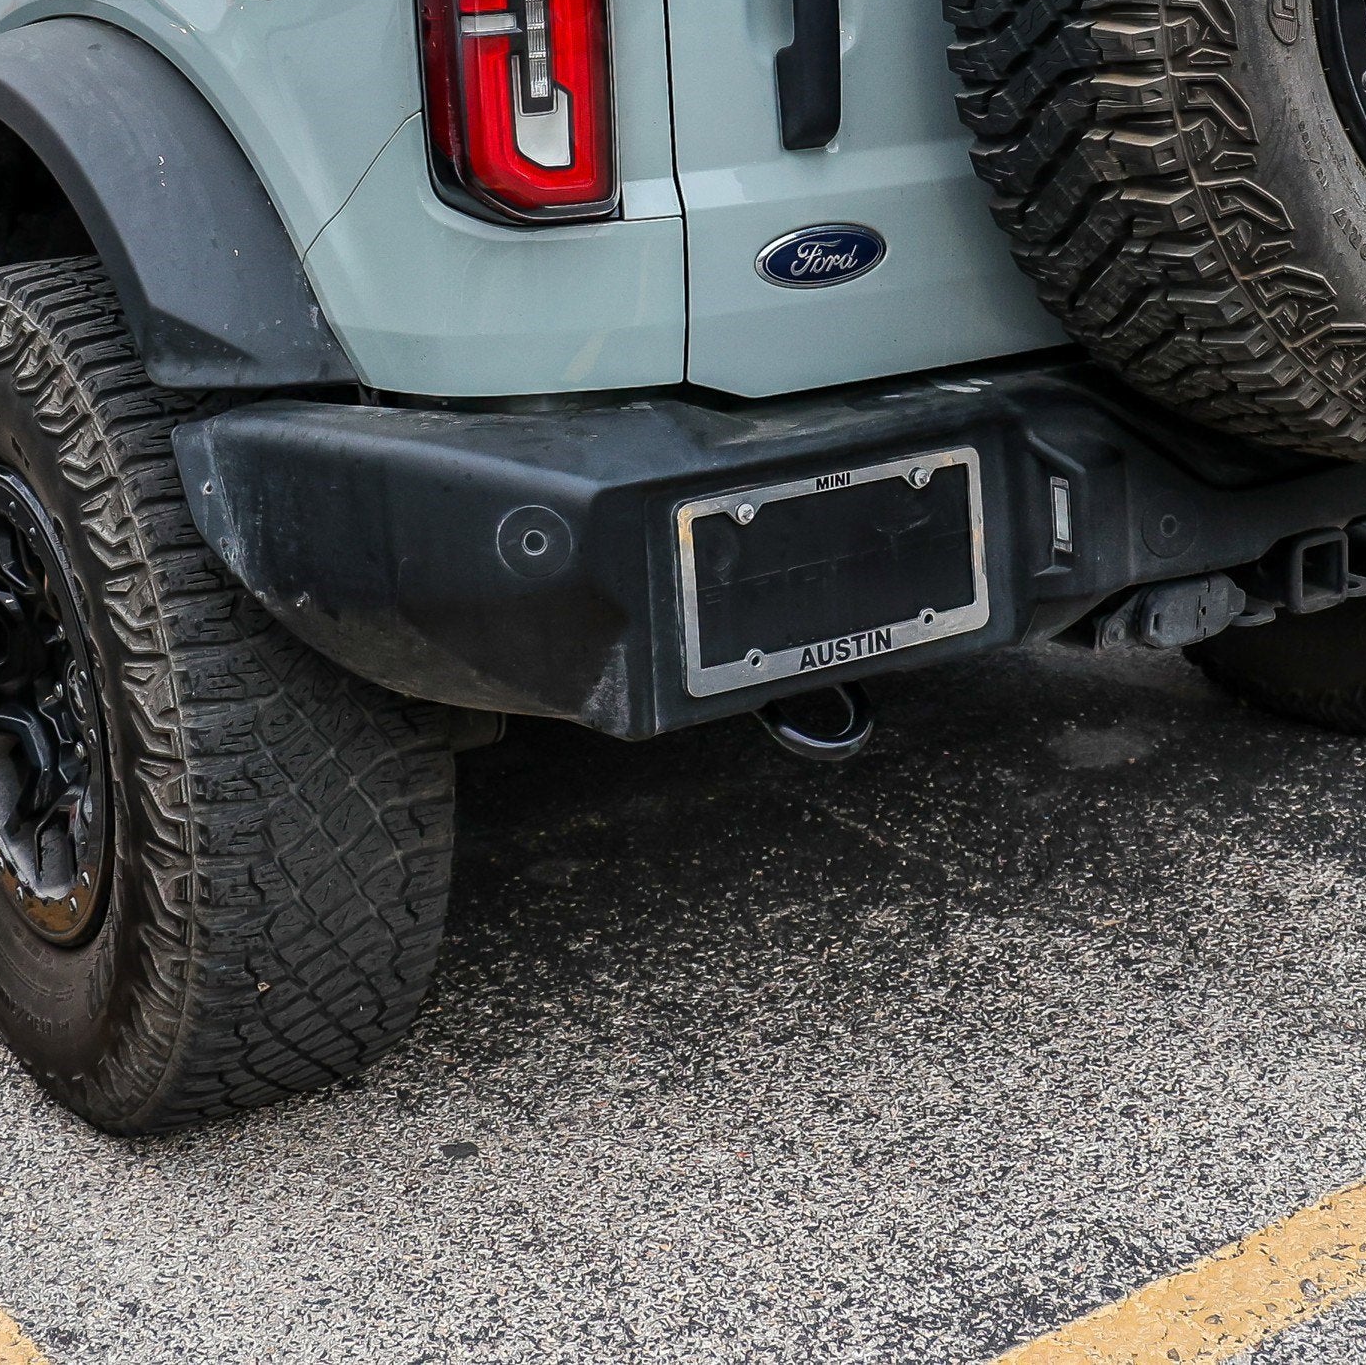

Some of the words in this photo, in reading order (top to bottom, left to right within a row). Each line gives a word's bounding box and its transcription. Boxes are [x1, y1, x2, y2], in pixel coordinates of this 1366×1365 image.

[790, 239, 859, 277] Ford
[815, 470, 852, 492] MINI
[799, 627, 892, 670] AUSTIN
